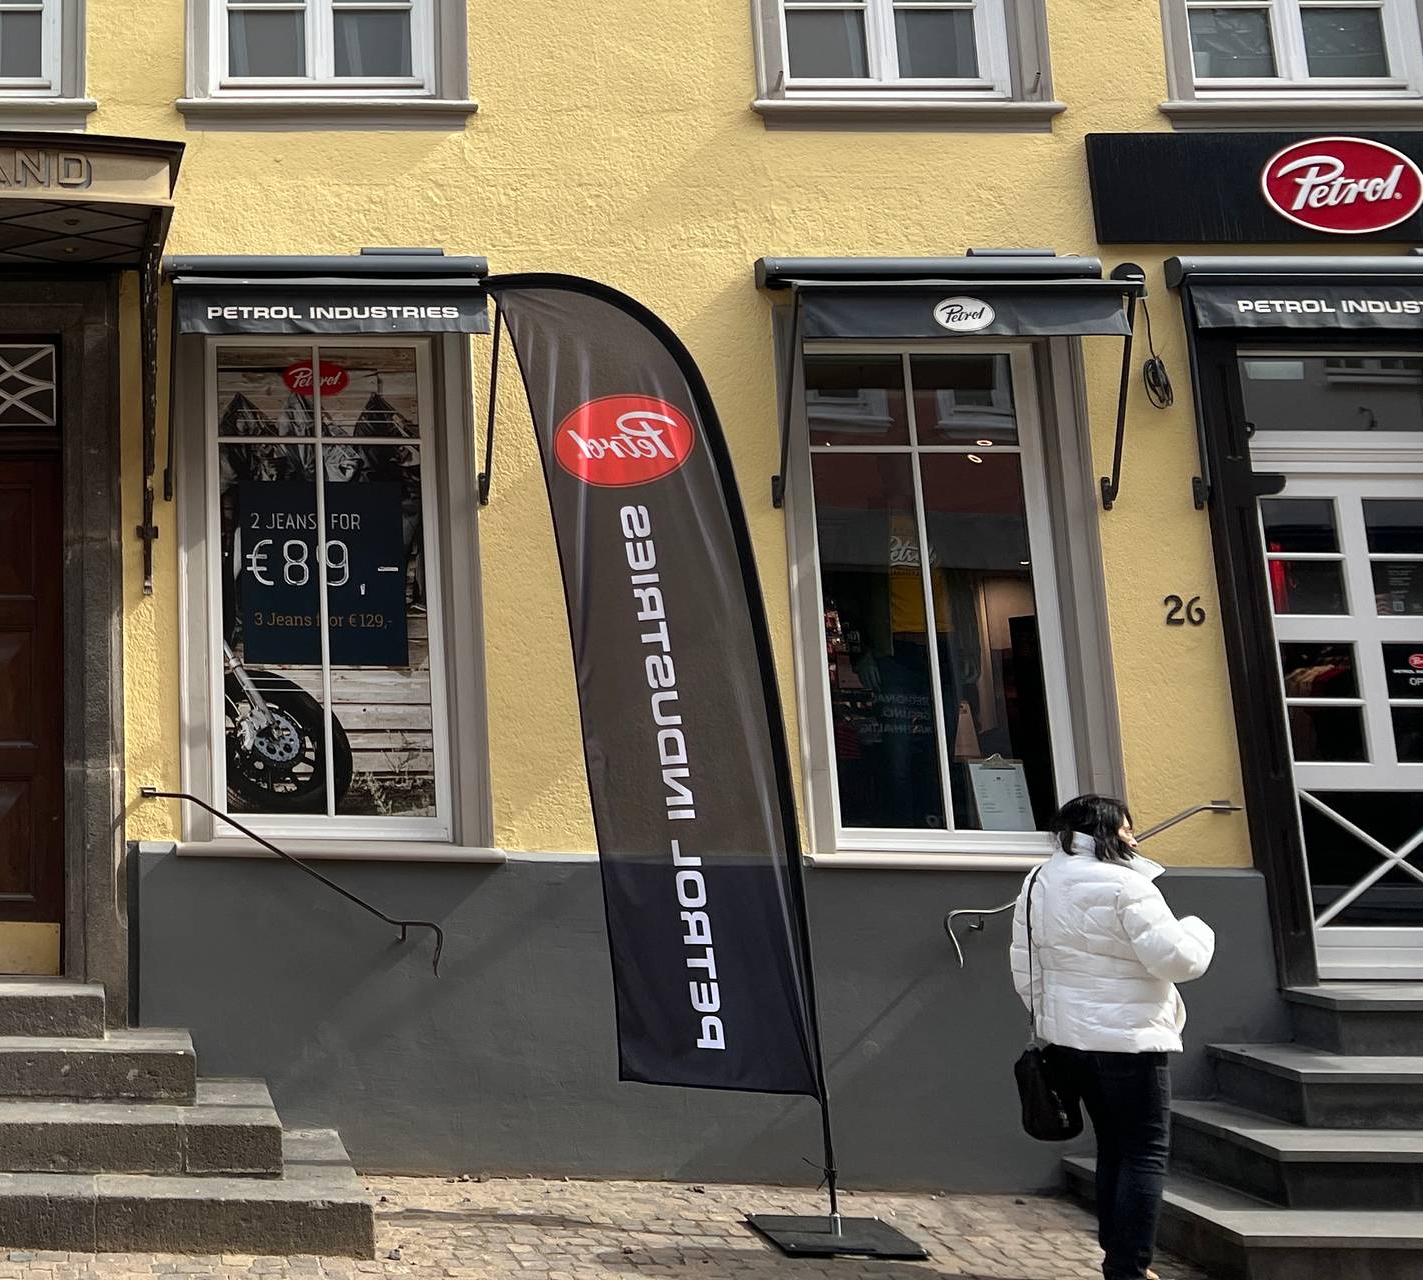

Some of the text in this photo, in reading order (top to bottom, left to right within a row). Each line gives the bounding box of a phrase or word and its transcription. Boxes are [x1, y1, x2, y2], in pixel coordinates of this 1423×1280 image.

[1276, 155, 1405, 211] Petrol
[207, 306, 460, 320] PETROL INDUSTRIES
[940, 304, 986, 323] Petrol
[1237, 300, 1423, 314] PETROL INDUS
[250, 512, 361, 530] 2 JEANS FOR
[1164, 594, 1206, 626] 26
[253, 612, 264, 626] 3
[267, 612, 312, 627] Jeans
